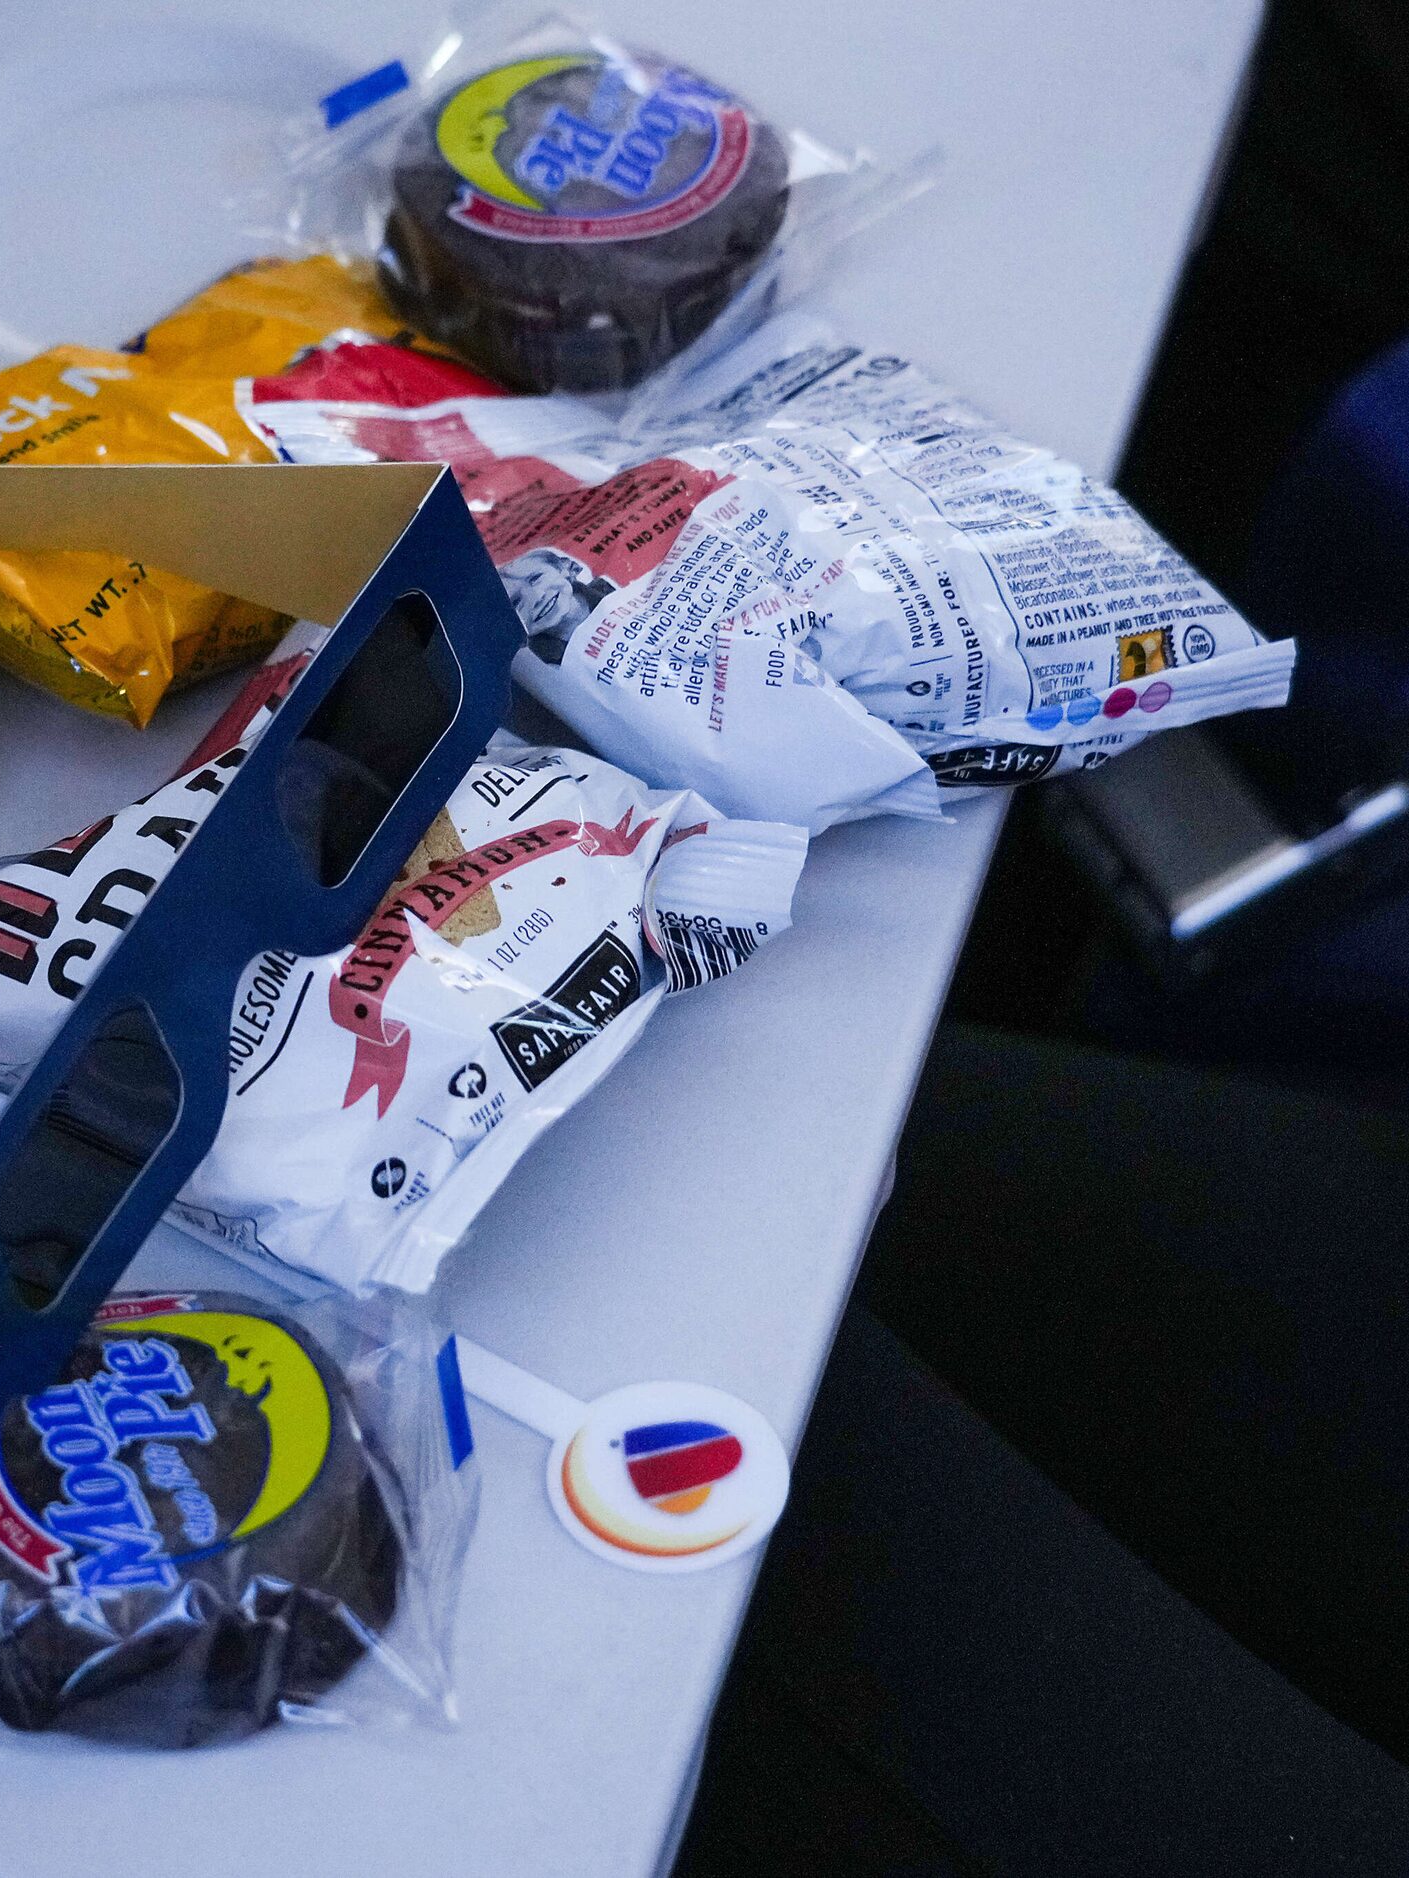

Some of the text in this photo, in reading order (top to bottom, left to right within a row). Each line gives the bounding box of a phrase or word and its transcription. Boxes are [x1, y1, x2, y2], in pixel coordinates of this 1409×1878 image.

[515, 104, 614, 192] Pie
[625, 531, 653, 552] AND
[645, 604, 681, 646] whole
[677, 563, 712, 609] grains
[709, 541, 734, 569] and
[937, 570, 961, 611] FOR:
[999, 561, 1050, 580] Sunflower
[85, 578, 129, 619] WT.
[596, 641, 630, 686] These
[623, 586, 675, 642] delicious
[669, 533, 719, 585] grahams
[897, 597, 926, 649] PROUDLY
[914, 593, 945, 648] NON-GMO
[1023, 603, 1103, 630] CONTAINS:
[584, 618, 618, 660] MADE
[1025, 633, 1055, 649] MADE
[1077, 624, 1113, 641] PEANUT
[1114, 619, 1133, 633] AND
[1133, 614, 1157, 629] TREE
[713, 652, 730, 691] MAKE
[708, 691, 724, 734] LET'S
[340, 831, 551, 994] CINNAMON
[496, 941, 521, 964] OZ
[515, 908, 555, 946] (28G)
[576, 964, 631, 1020] FAIR
[92, 1339, 218, 1446] Pie
[24, 1378, 180, 1595] Moon
